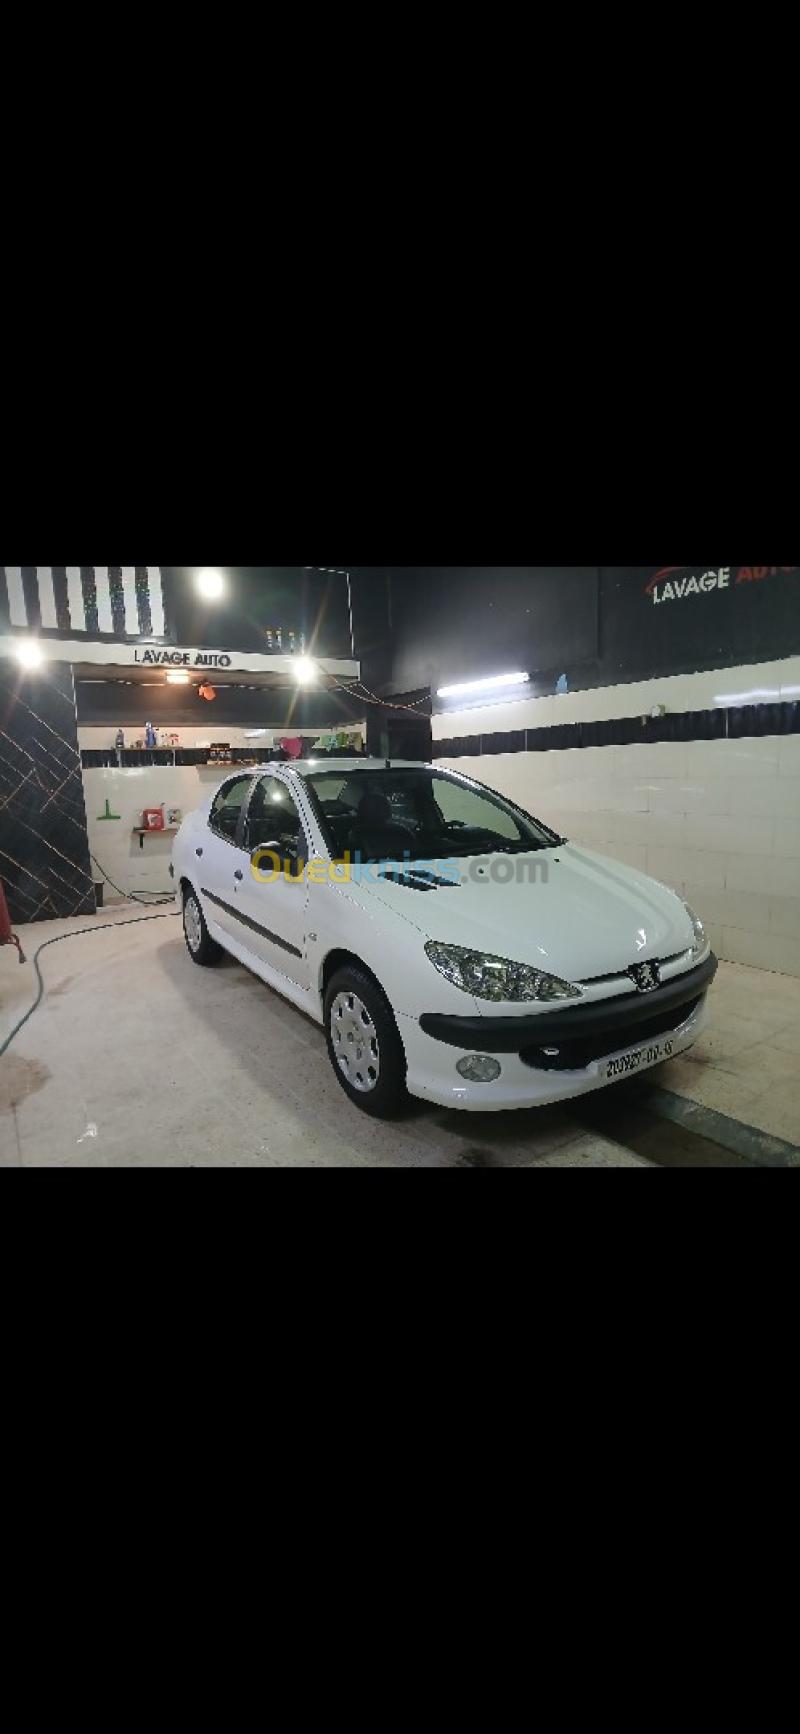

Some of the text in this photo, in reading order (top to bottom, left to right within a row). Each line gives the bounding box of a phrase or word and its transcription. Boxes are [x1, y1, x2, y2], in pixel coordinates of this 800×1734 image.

[653, 567, 730, 604] LAVAGE
[134, 650, 231, 667] LAVAGE AUTO
